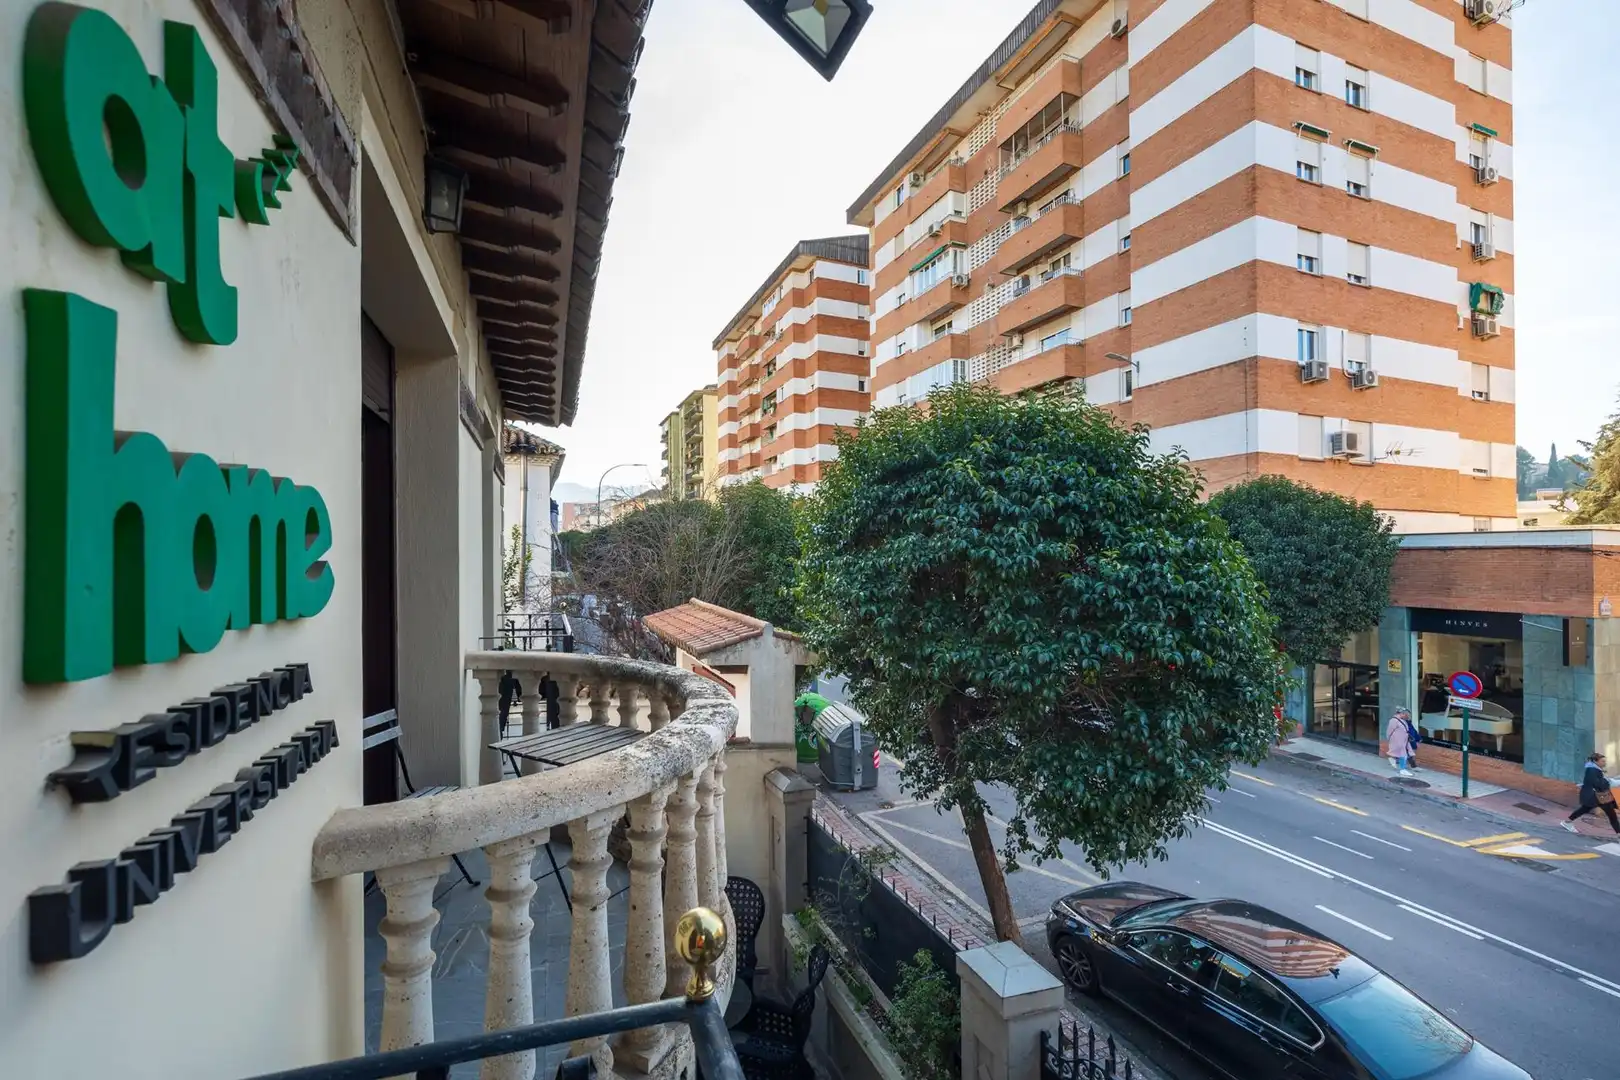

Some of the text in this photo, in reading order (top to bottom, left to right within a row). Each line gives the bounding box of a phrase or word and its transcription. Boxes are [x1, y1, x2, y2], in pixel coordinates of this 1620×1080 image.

[24, 1, 238, 345] at
[22, 288, 335, 683] home
[1445, 619, 1488, 628] HINVES
[28, 719, 339, 965] UNIVERSITARIA
